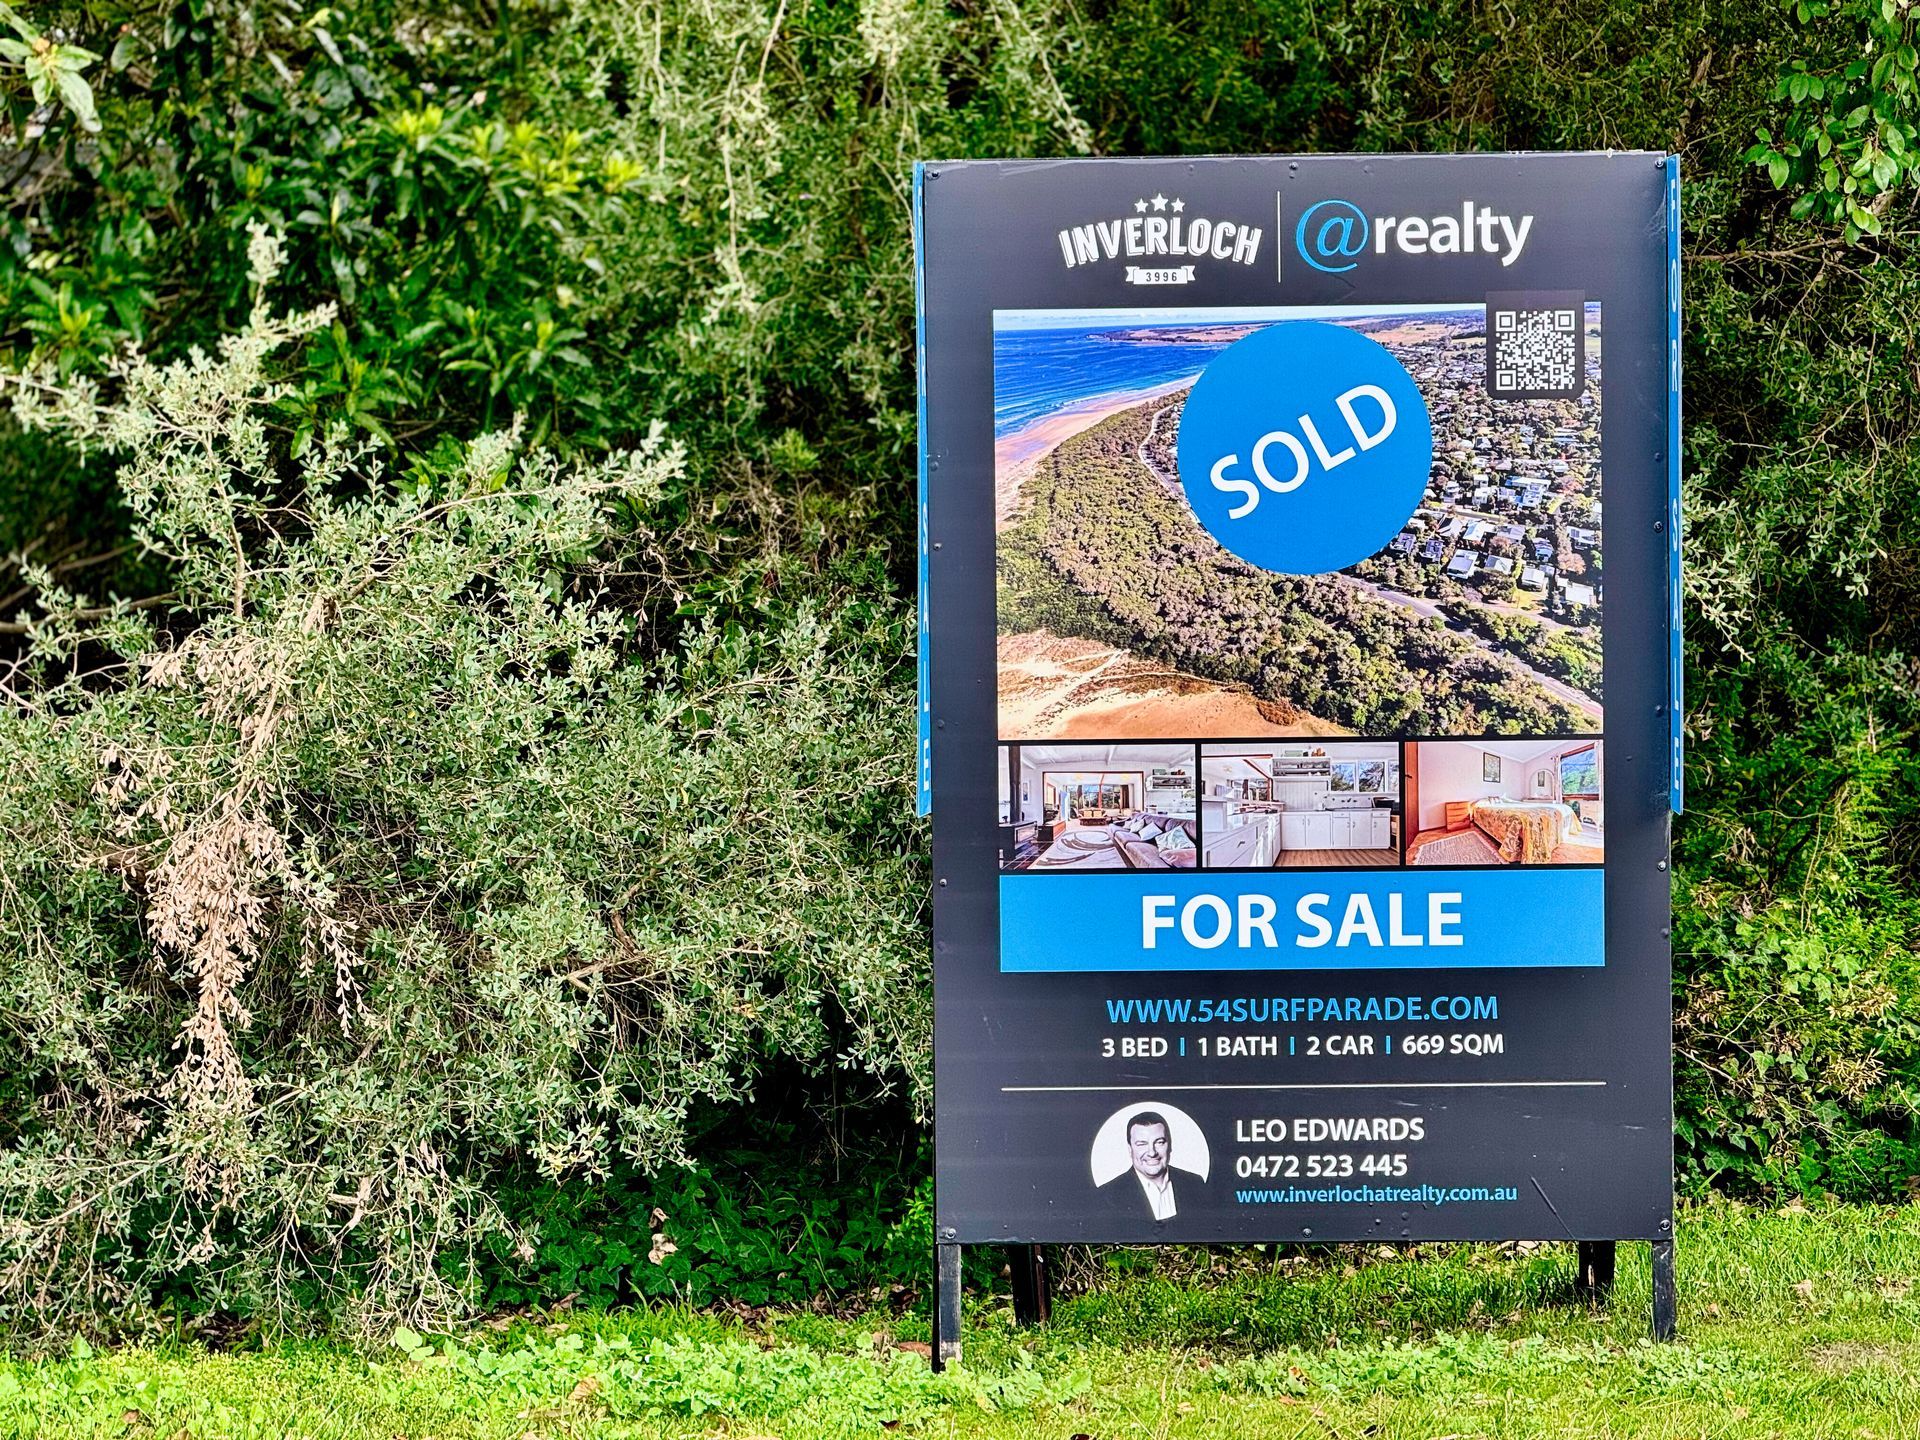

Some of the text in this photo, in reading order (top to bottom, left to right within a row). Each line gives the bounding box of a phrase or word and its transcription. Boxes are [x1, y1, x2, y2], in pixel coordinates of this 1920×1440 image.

[1058, 216, 1262, 267] INVERLOCH
[1145, 271, 1179, 283] 3996
[1210, 382, 1399, 520] SOLD
[1141, 891, 1465, 949] FOR SALE
[1107, 996, 1499, 1023] WWW.54SURFPARADE.COM
[1102, 1034, 1504, 1057] 3 BED 1 BATH 2 CAR 669 SQM
[1236, 1117, 1425, 1142] LEO EDWARDS
[1236, 1154, 1408, 1178] 0472 523 445
[1236, 1185, 1518, 1206] www.inverlochatrealty.com.au
